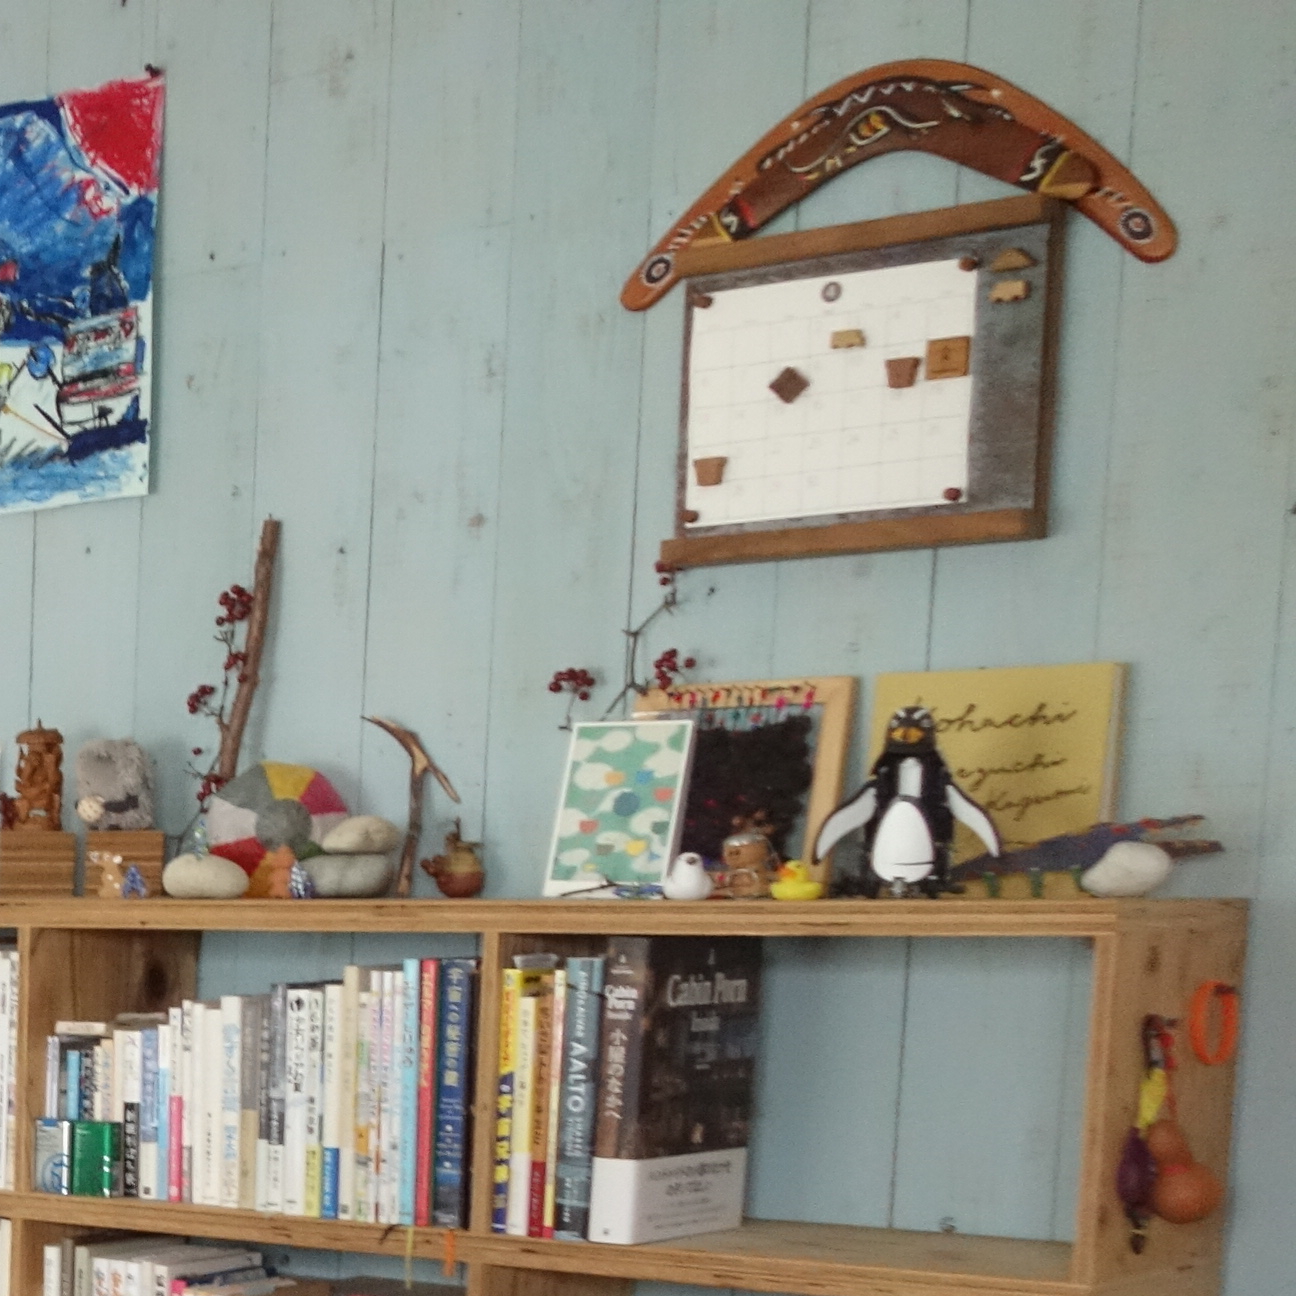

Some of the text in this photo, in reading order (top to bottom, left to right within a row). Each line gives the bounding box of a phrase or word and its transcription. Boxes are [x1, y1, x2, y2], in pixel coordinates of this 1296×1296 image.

[666, 973, 750, 1007] Cabin Porn
[565, 1041, 589, 1113] AALTO
